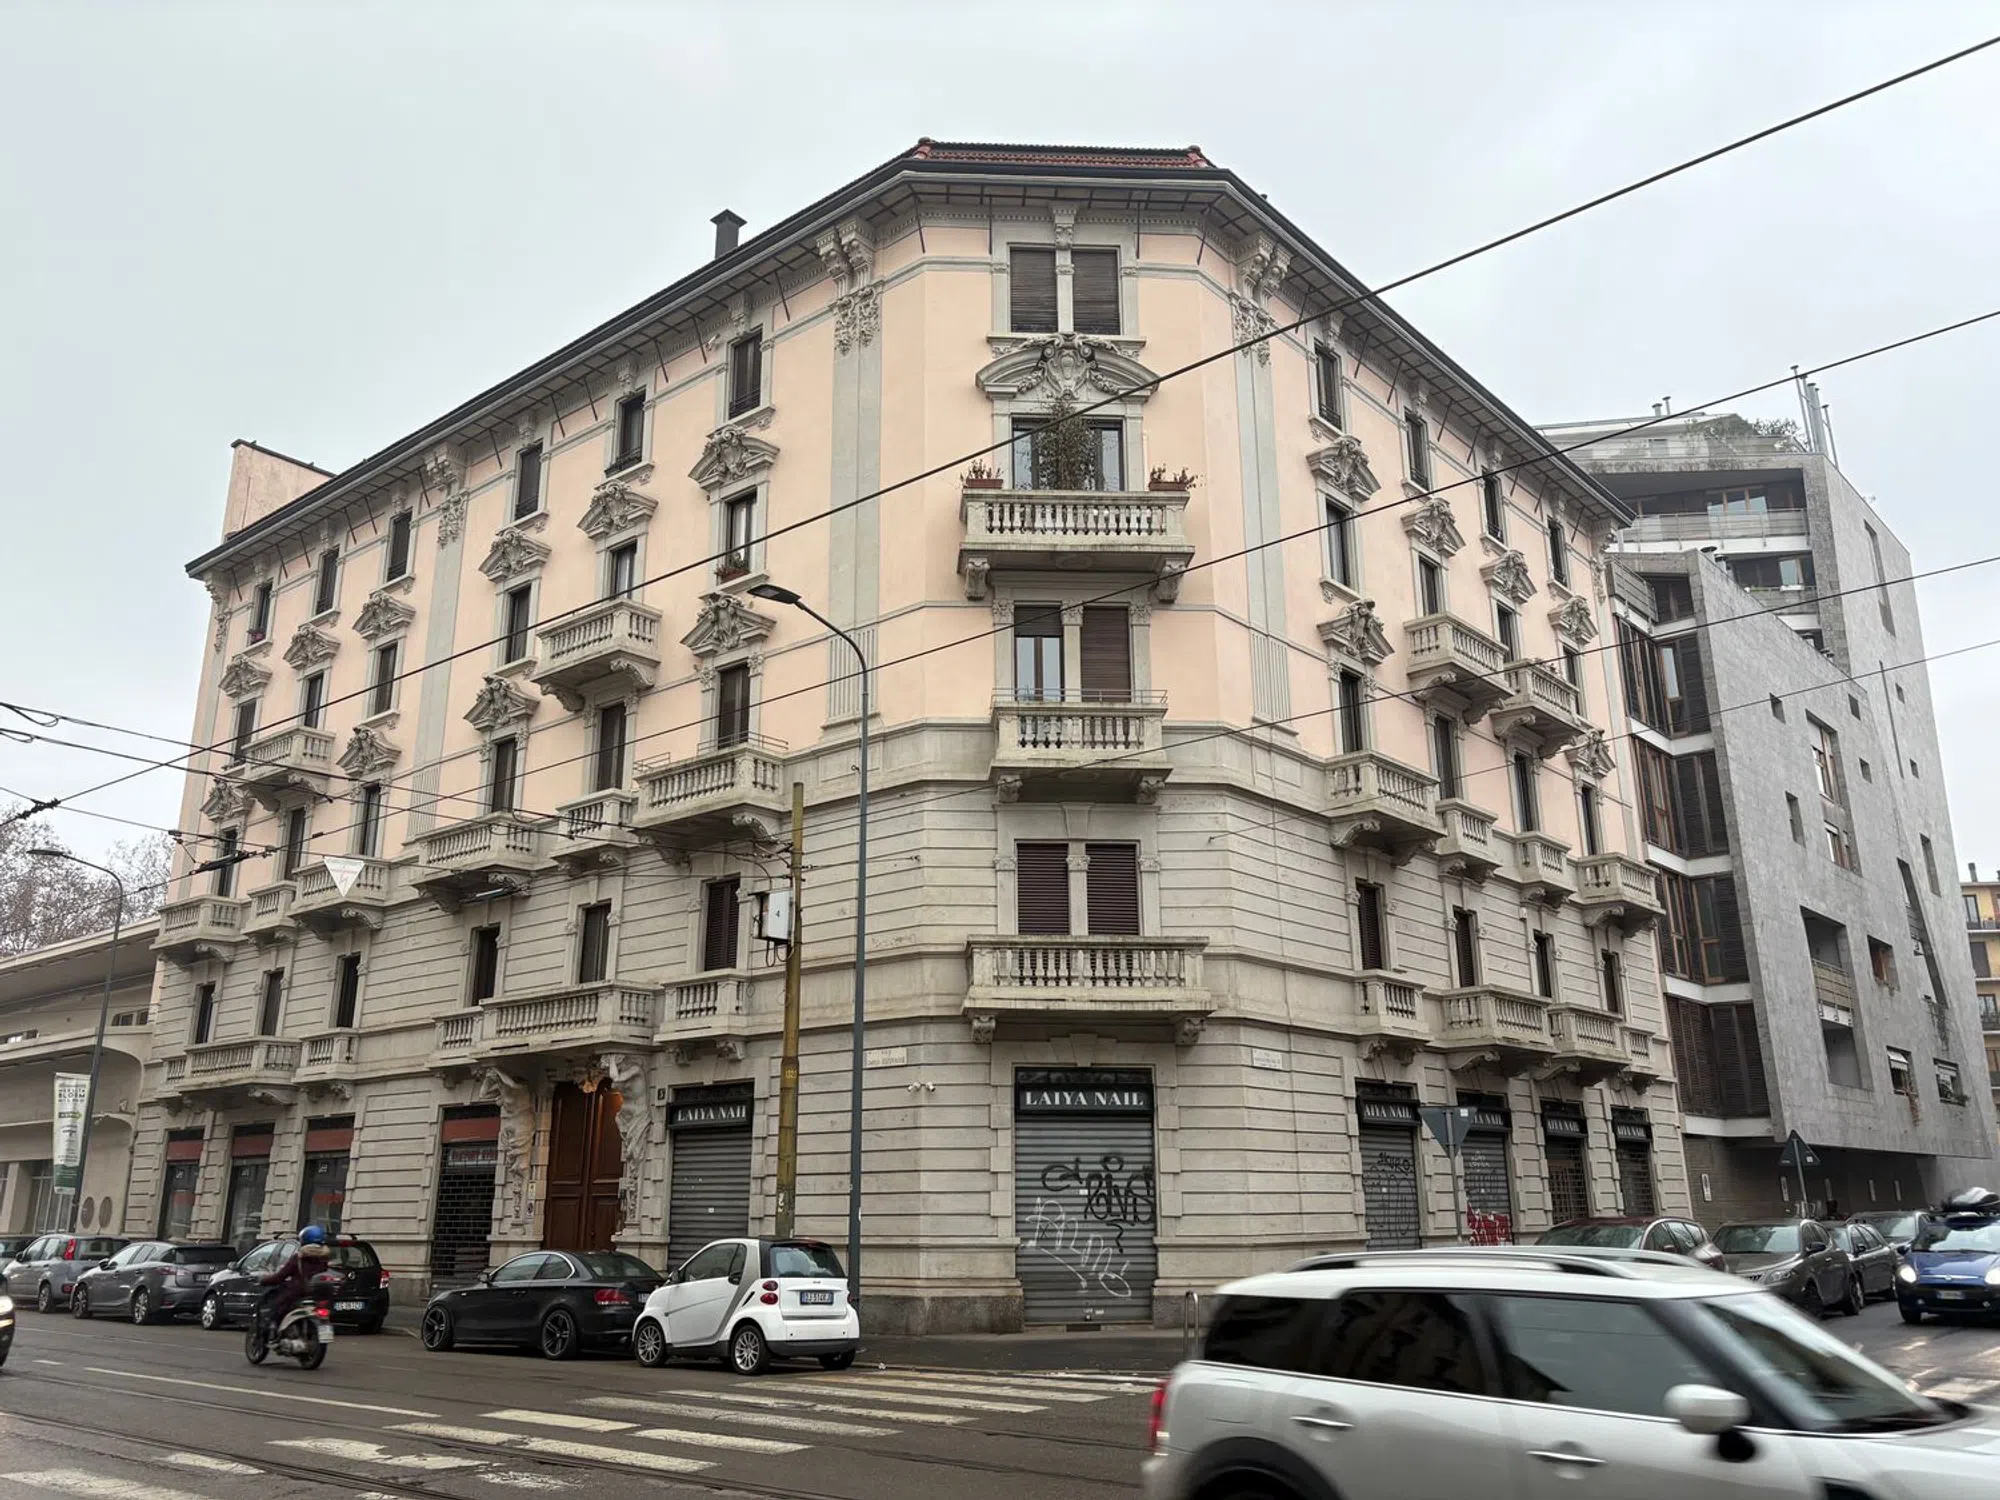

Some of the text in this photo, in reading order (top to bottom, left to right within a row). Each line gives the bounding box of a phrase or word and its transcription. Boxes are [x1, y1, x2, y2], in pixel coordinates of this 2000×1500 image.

[1025, 1091, 1144, 1106] LAIYA NAIL
[1389, 1104, 1412, 1119] NAIL
